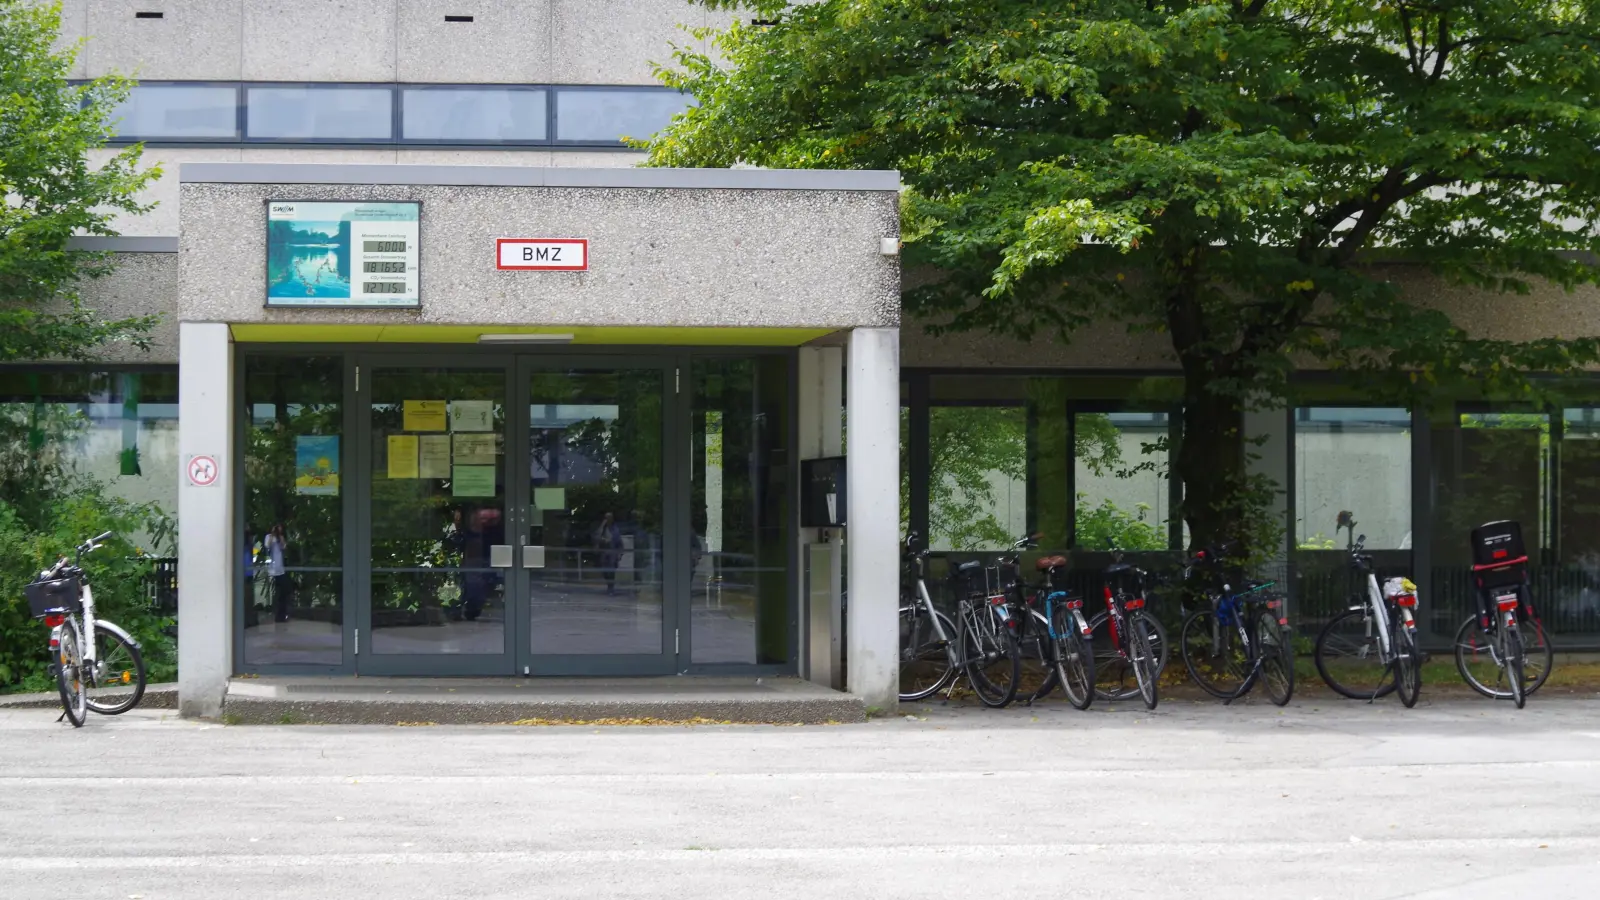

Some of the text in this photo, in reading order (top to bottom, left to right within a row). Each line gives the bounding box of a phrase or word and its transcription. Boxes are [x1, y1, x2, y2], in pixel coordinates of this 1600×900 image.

[377, 241, 405, 252] 6000
[523, 247, 562, 261] BMZ
[366, 262, 405, 273] 181652
